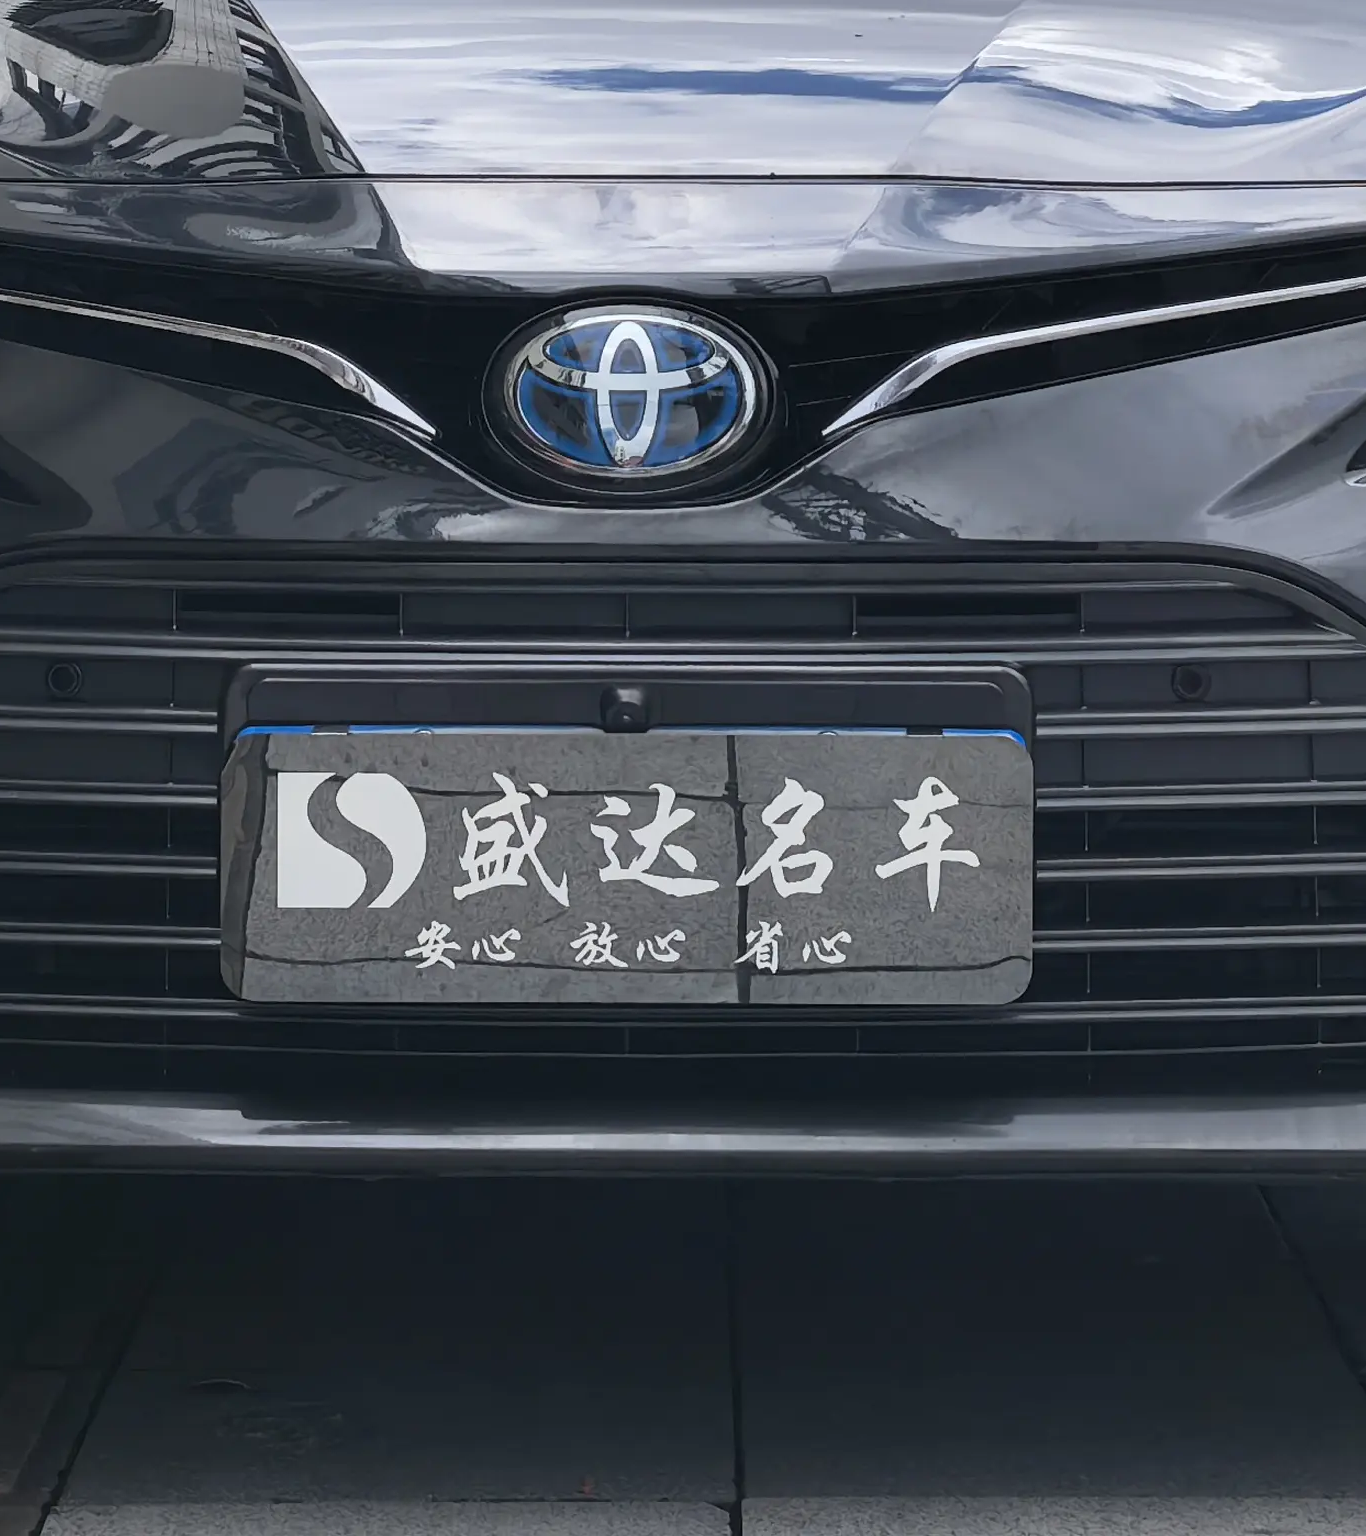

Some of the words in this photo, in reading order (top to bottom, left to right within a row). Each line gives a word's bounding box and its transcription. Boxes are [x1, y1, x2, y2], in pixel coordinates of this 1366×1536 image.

[454, 772, 981, 913] 盛达名车
[404, 920, 521, 970] 安心
[570, 921, 686, 968] 放心
[734, 920, 852, 974] 省心
